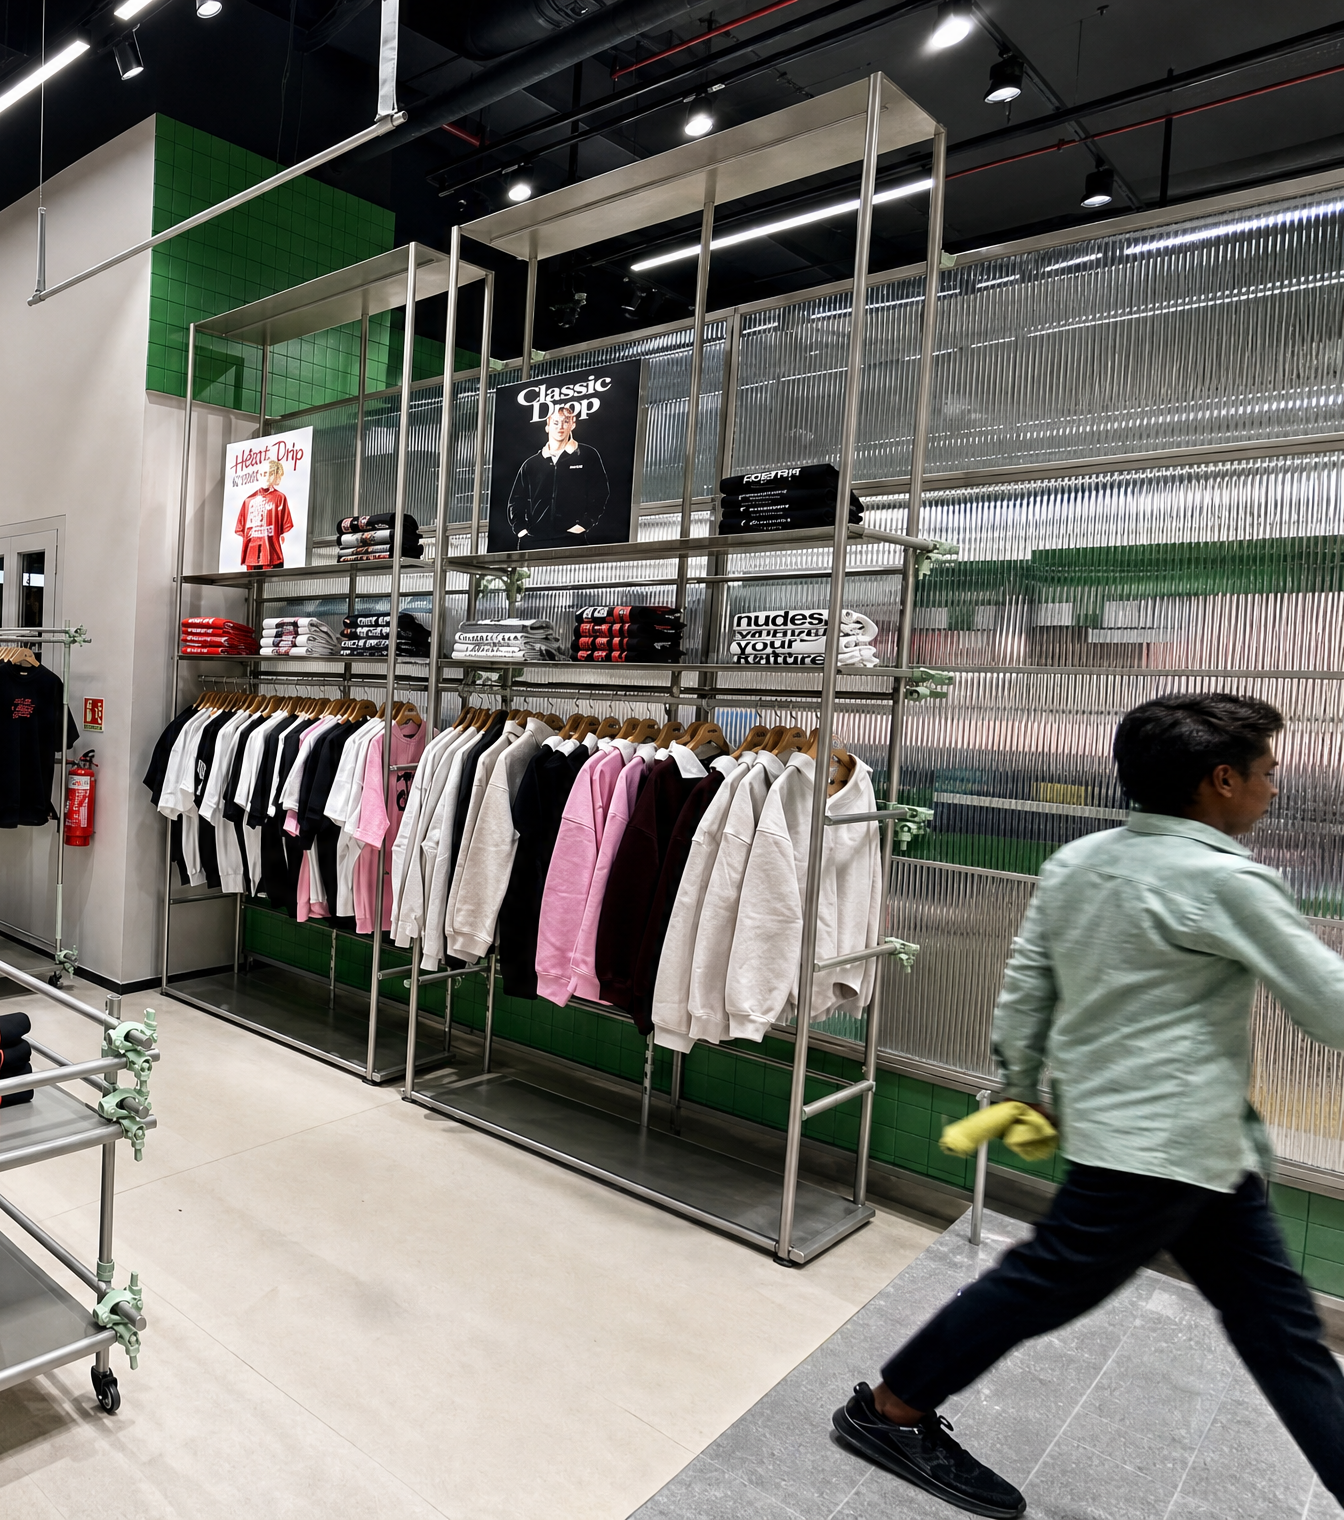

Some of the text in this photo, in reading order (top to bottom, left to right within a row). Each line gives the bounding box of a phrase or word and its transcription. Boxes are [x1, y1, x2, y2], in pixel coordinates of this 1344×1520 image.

[517, 375, 612, 406] Classic
[530, 397, 601, 423] Drop
[271, 440, 304, 471] Drip
[736, 638, 798, 655] your
